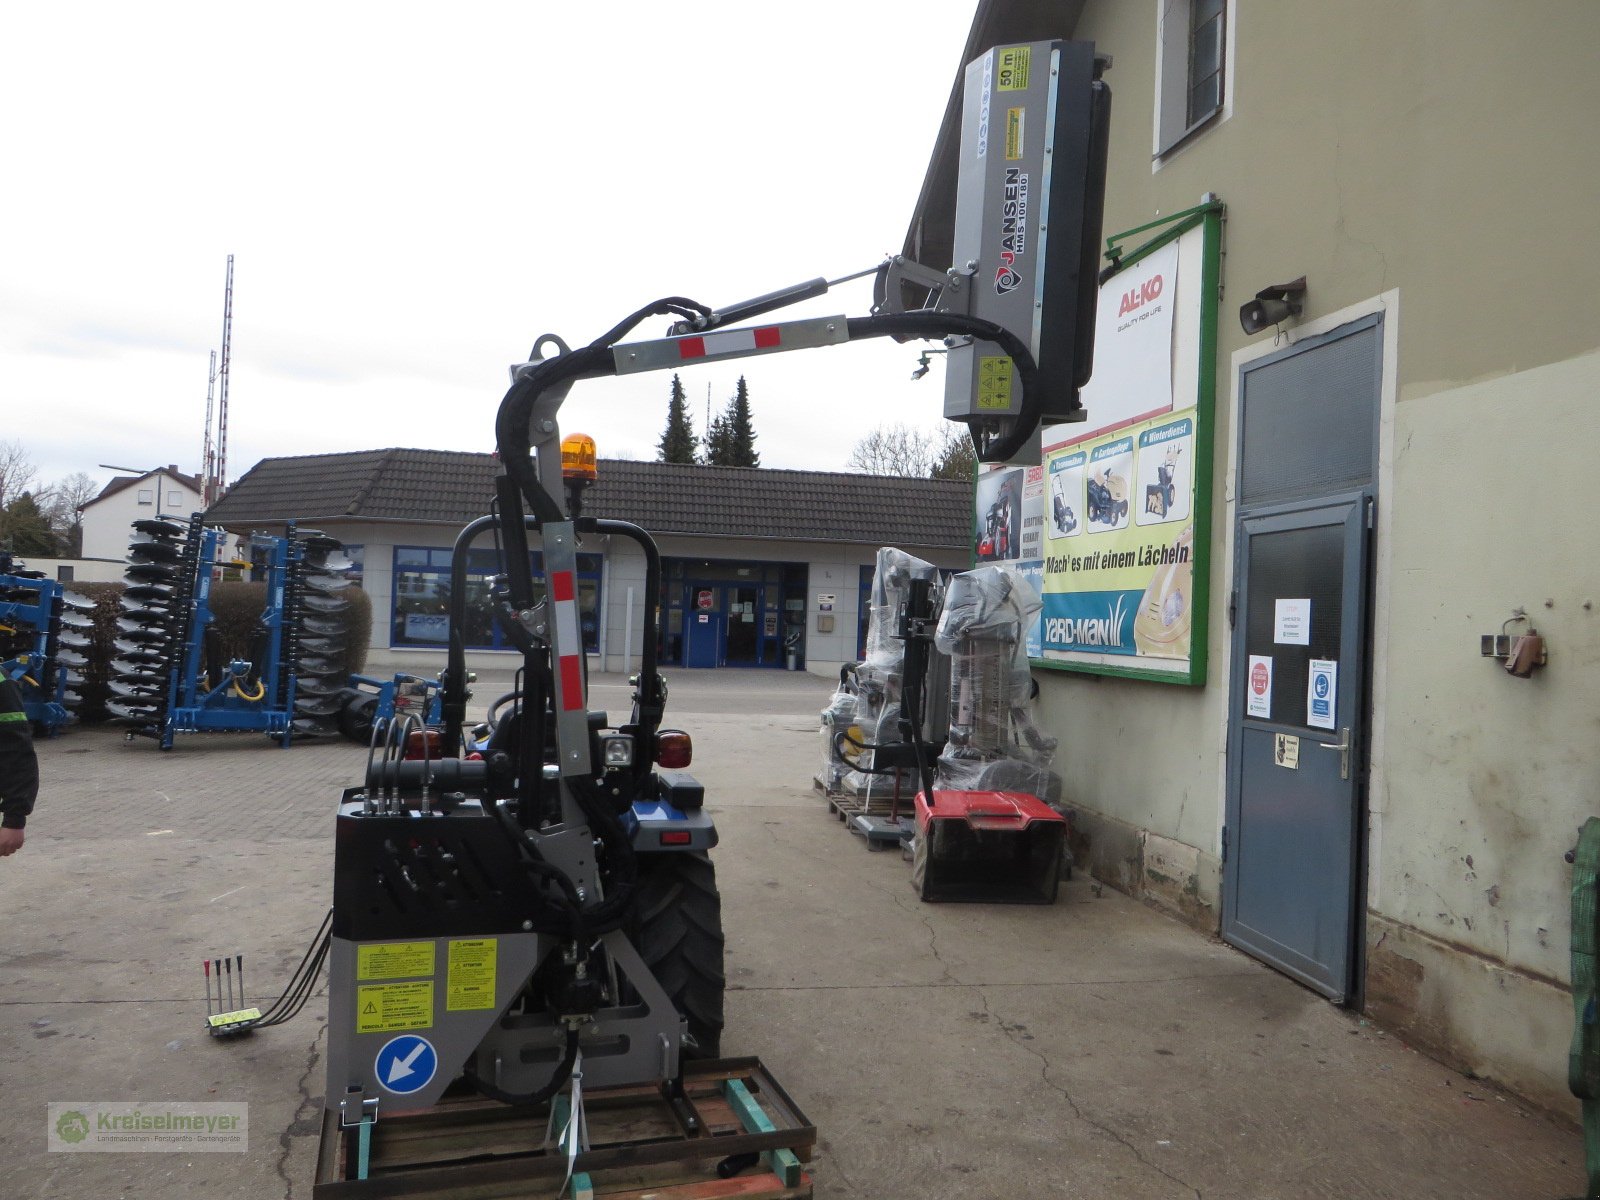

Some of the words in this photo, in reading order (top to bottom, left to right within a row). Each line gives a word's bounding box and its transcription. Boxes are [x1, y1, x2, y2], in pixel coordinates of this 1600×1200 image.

[1004, 54, 1013, 66] m
[1000, 70, 1013, 86] 50
[1001, 168, 1019, 265] JANSEN
[1118, 274, 1163, 318] AL-KO
[1118, 318, 1138, 332] QUALITY
[1139, 312, 1150, 322] FOR
[1150, 306, 1162, 316] LIFE
[1148, 422, 1187, 444] Winterdienst
[1046, 556, 1070, 574] Mach'
[1072, 559, 1081, 571] es
[1083, 552, 1100, 570] mit
[1102, 550, 1136, 569] einem
[1138, 542, 1189, 566] Lächeln
